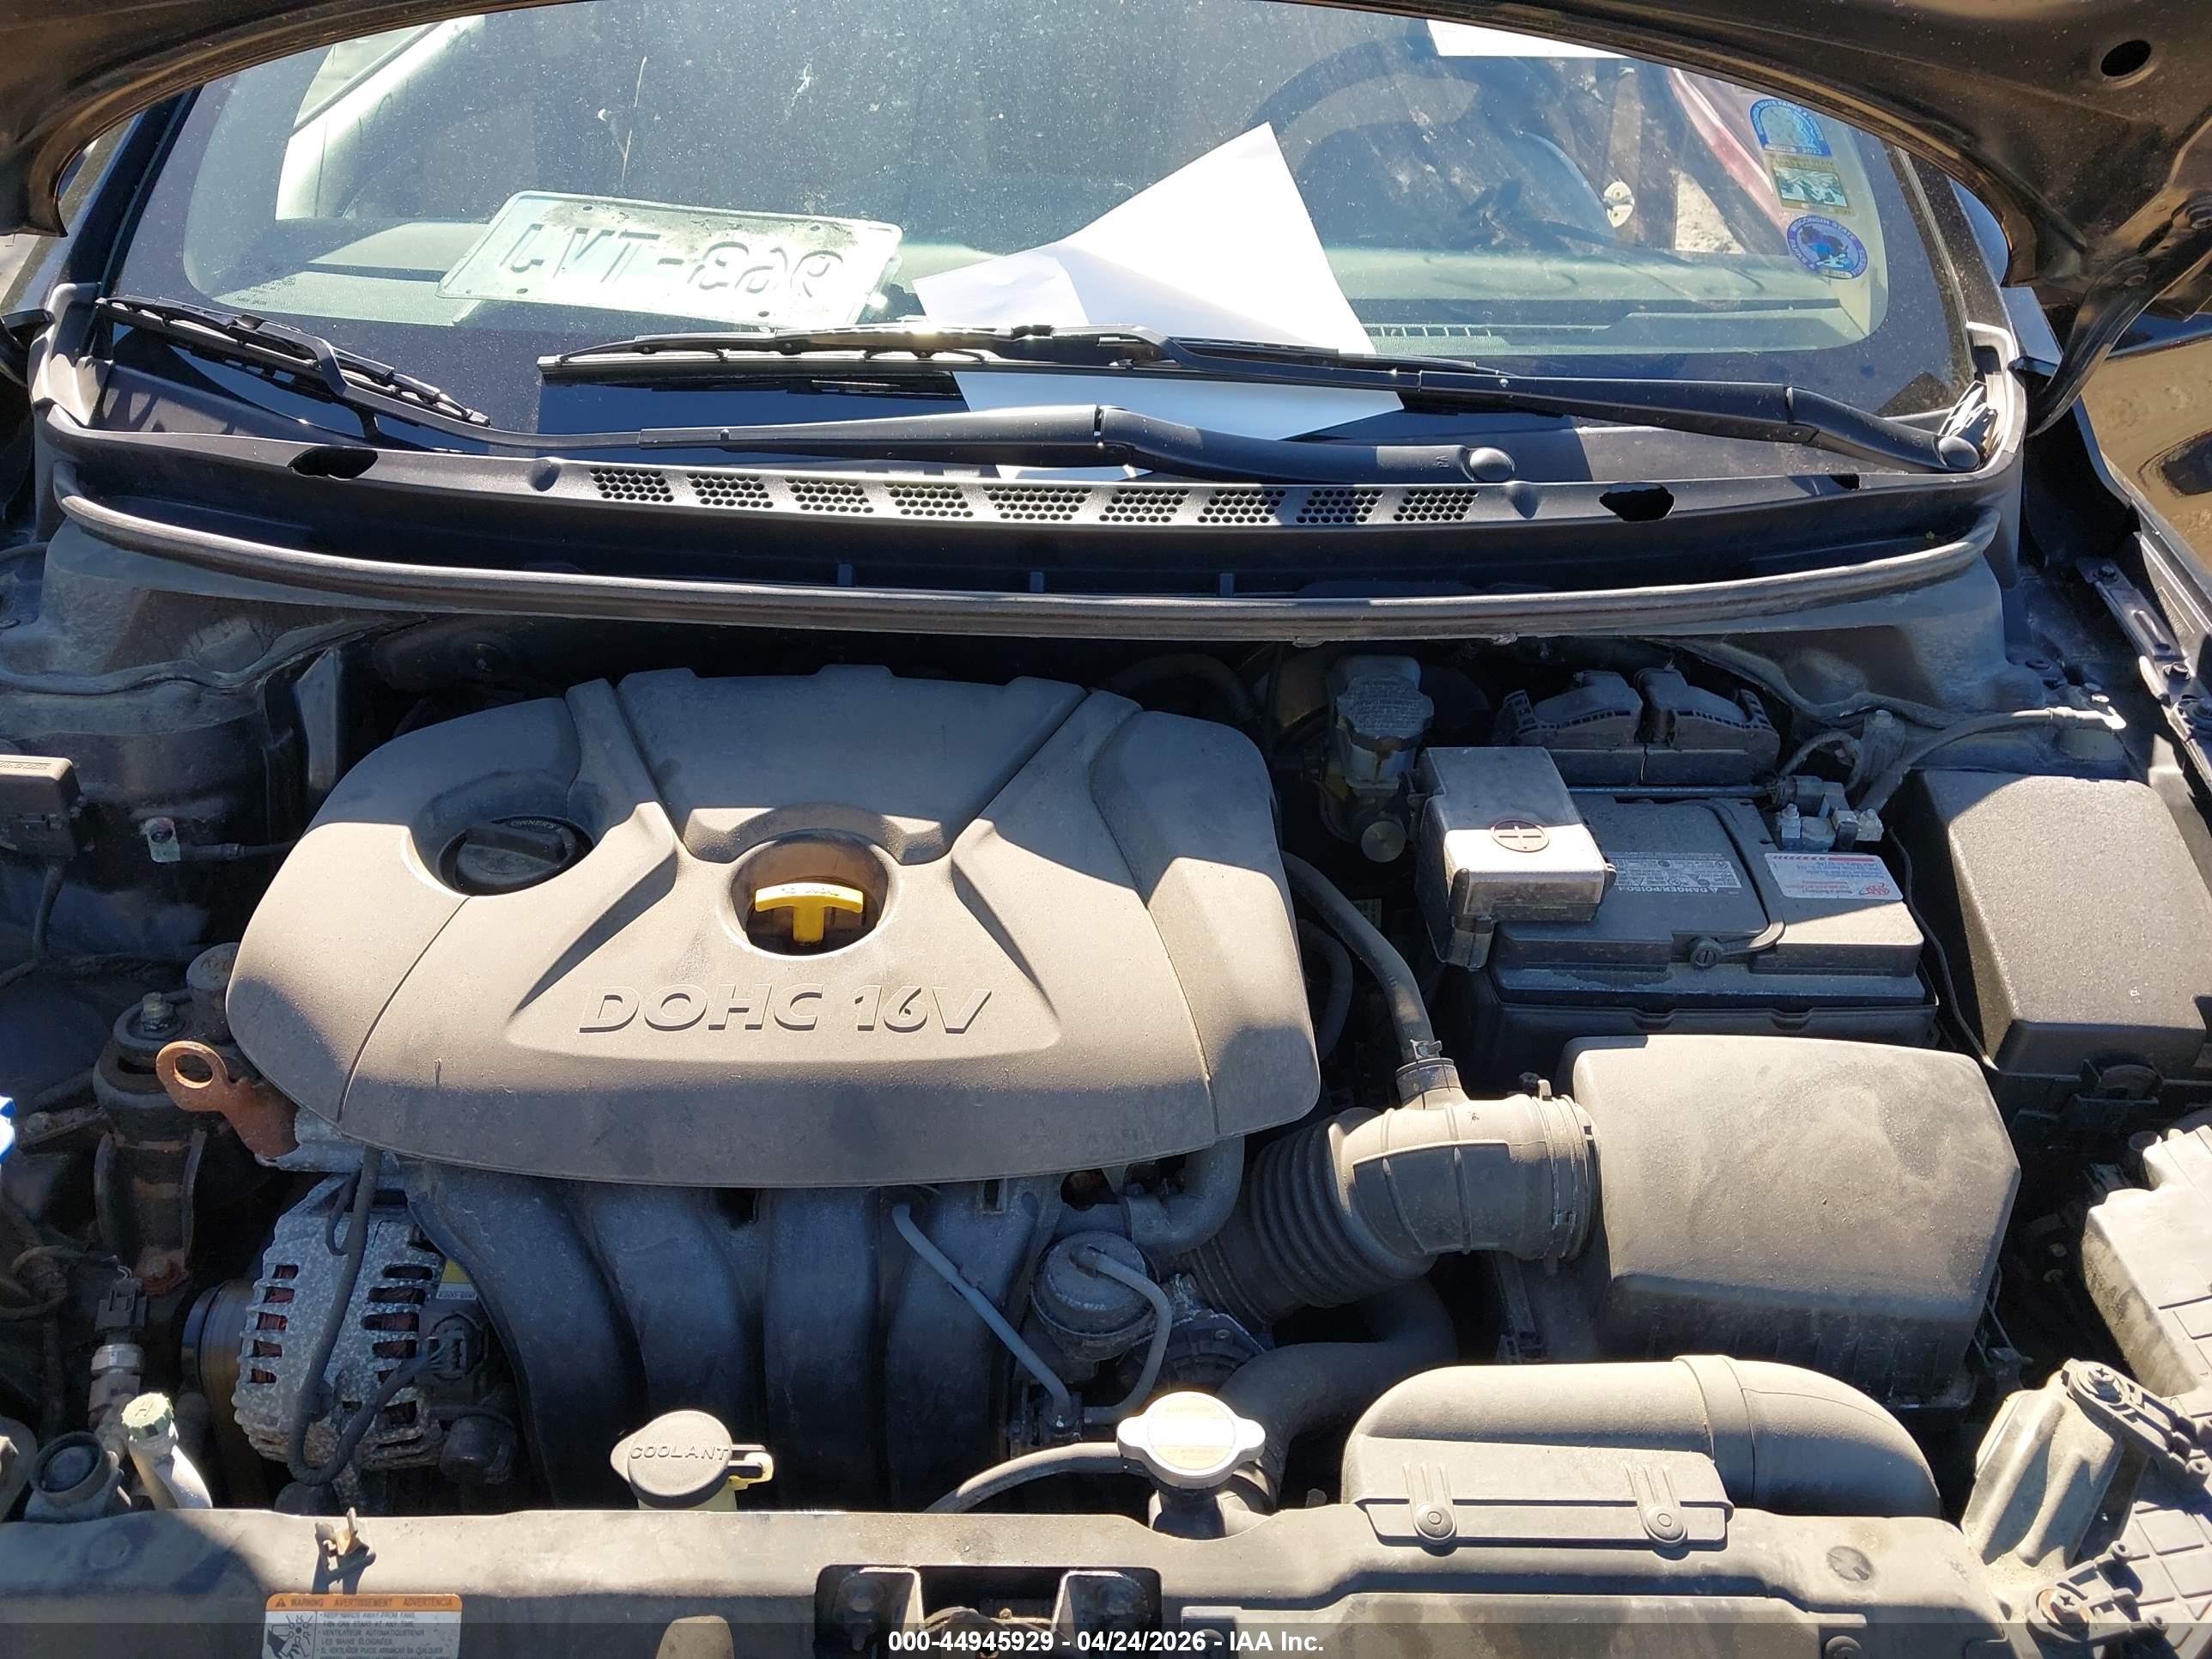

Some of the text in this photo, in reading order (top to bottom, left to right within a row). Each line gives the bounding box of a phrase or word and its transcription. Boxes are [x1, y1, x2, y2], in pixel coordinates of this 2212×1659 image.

[579, 983, 993, 1035] DOHC 16V
[629, 1444, 729, 1461] COOLANT
[290, 1597, 453, 1607] WARNING AVERTISSEMENT ADVERTENCIA
